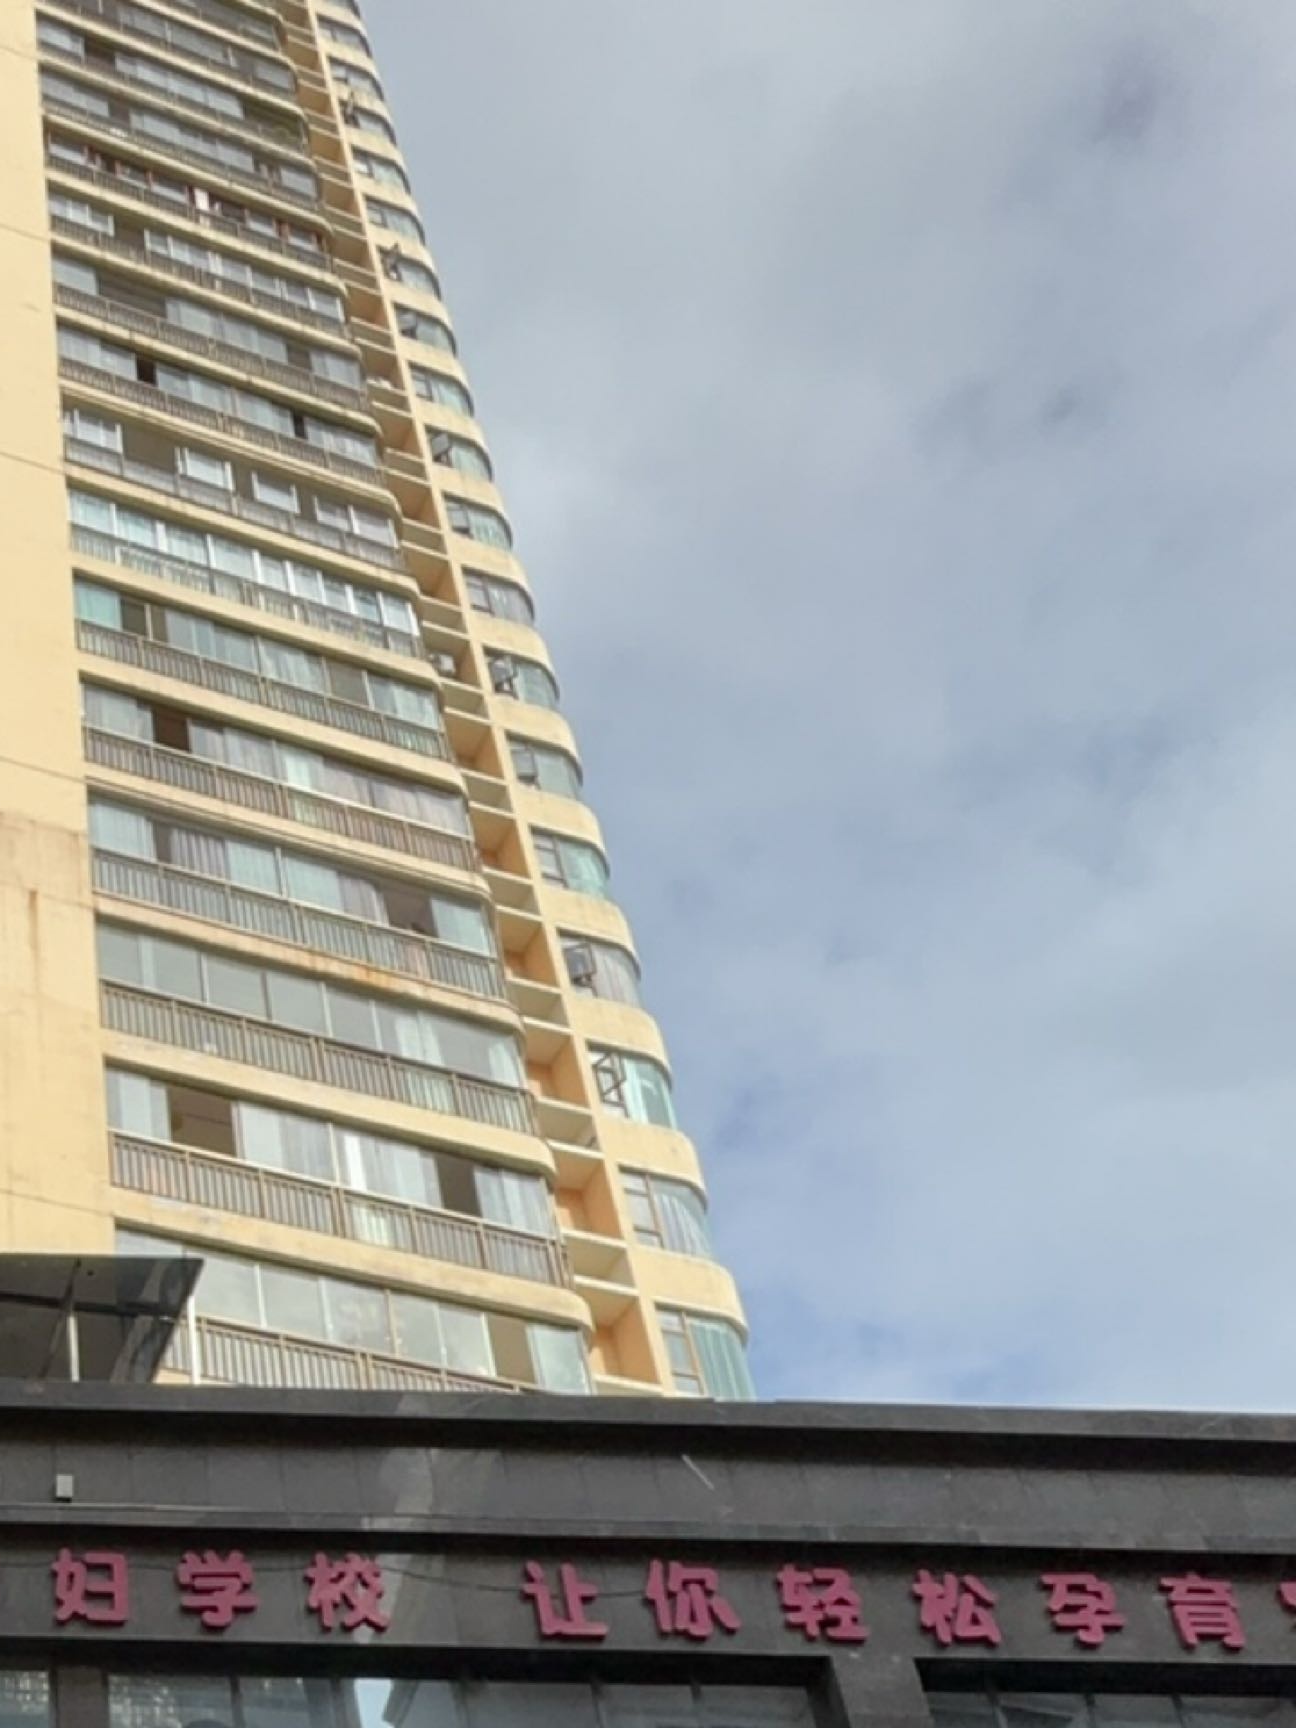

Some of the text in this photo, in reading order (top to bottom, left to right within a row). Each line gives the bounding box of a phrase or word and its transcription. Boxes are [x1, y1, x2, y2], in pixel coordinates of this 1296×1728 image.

[522, 1559, 1296, 1652] 让你轻松孕育
